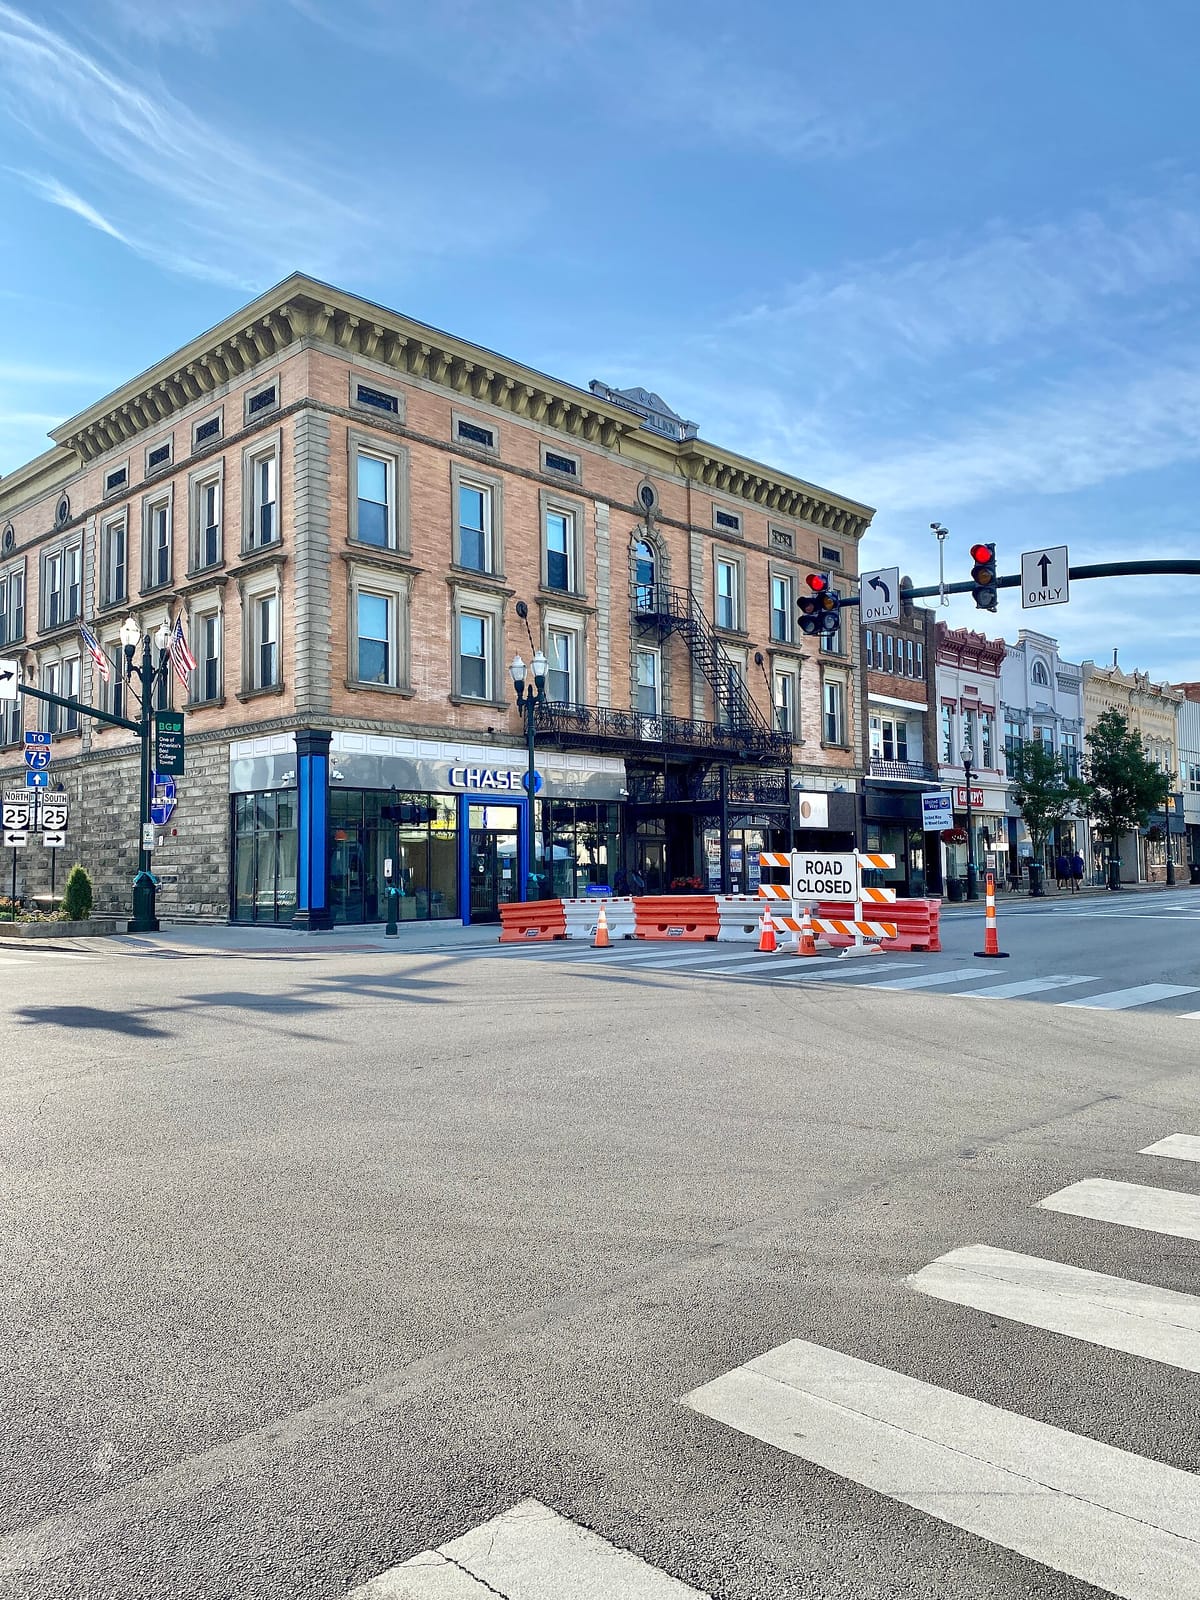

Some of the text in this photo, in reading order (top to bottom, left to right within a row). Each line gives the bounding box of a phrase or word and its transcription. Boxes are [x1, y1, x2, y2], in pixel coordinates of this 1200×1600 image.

[1028, 588, 1062, 603] ONLY
[866, 604, 894, 619] ONLY
[31, 733, 45, 742] TO
[28, 751, 47, 767] 75
[450, 767, 522, 790] CHASE
[4, 791, 29, 801] NORTH
[44, 793, 67, 803] SOUTH
[5, 809, 27, 824] 25
[44, 810, 65, 824] 25
[805, 860, 843, 876] ROAD
[797, 879, 853, 895] CLOSED
